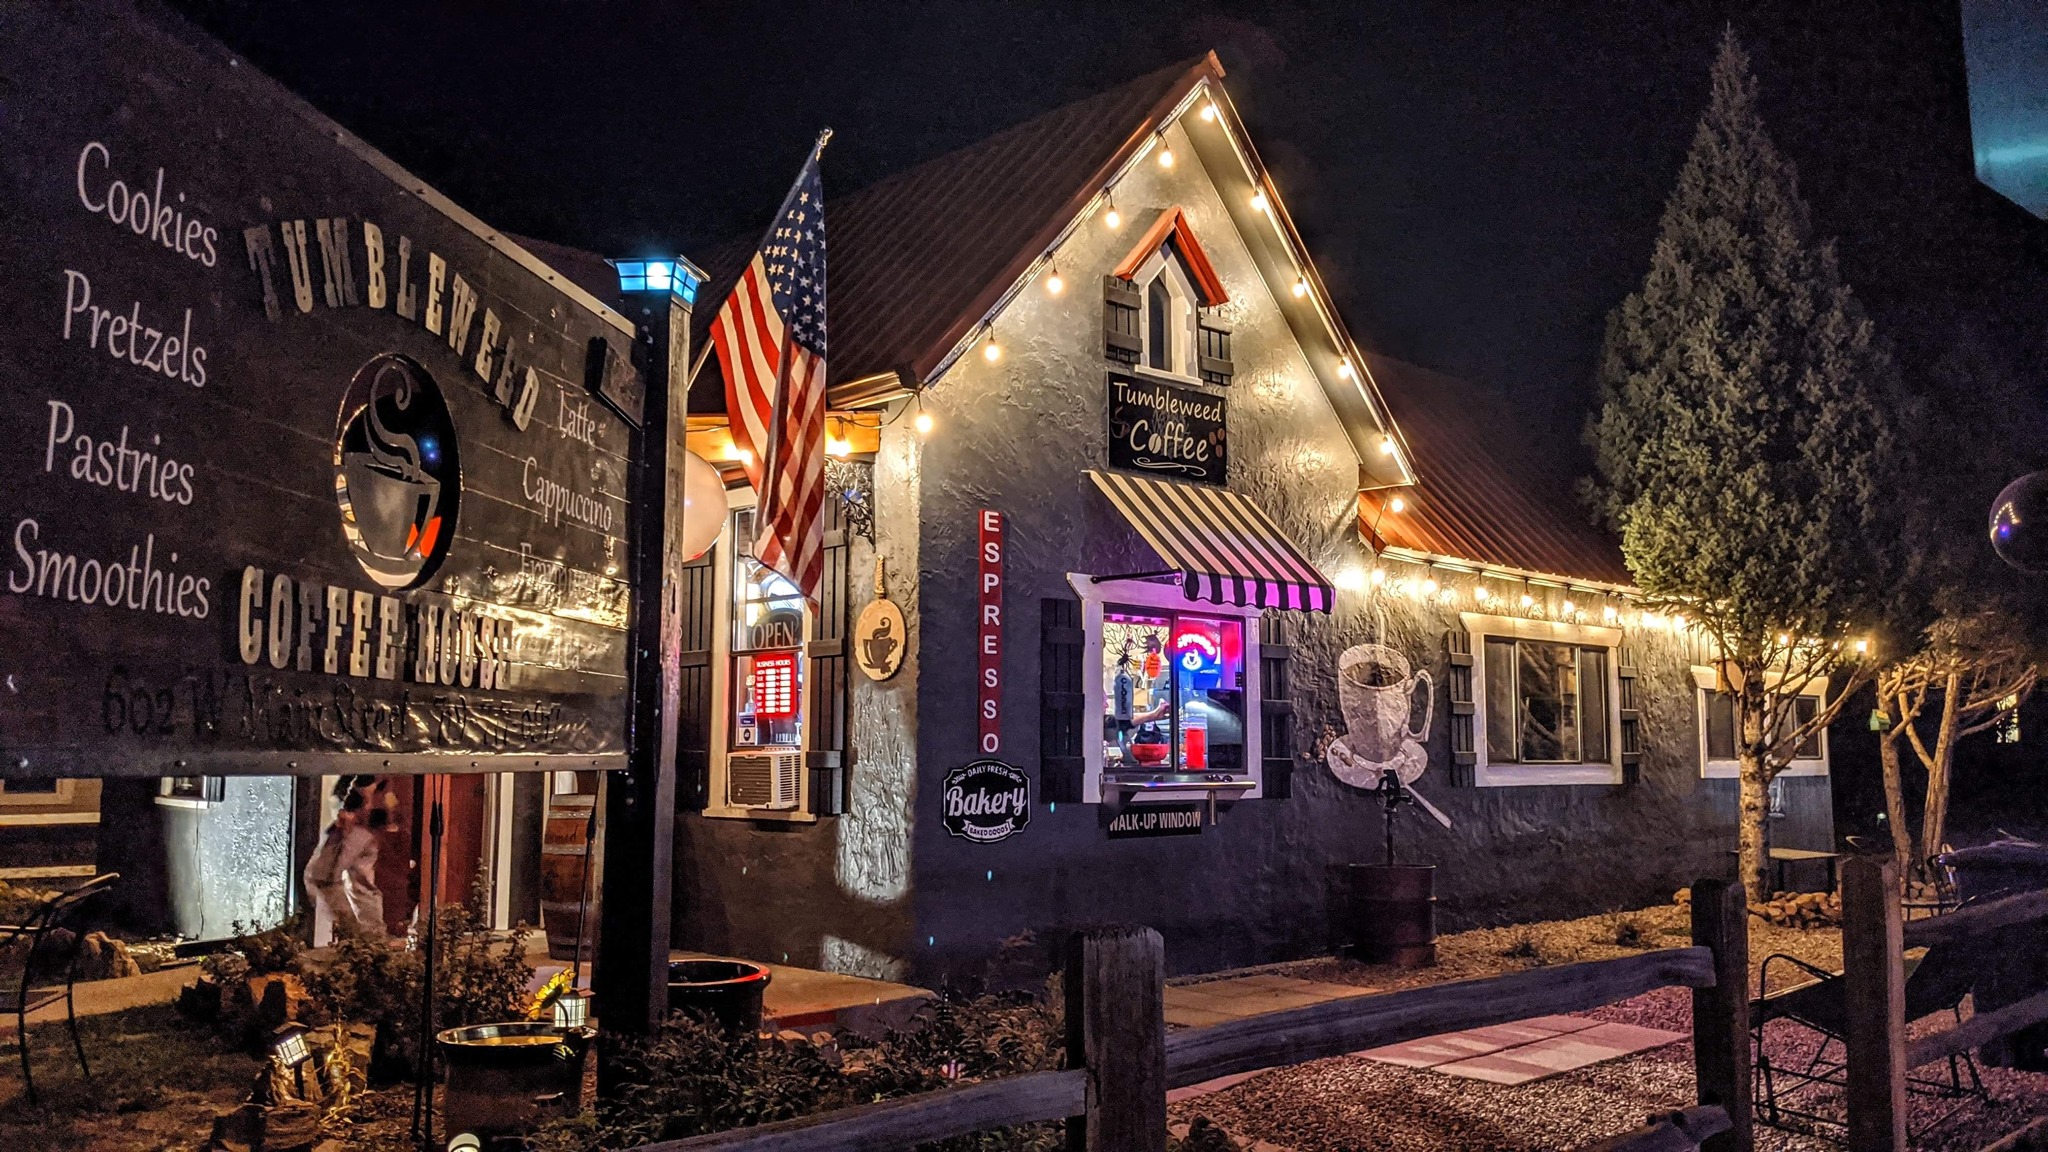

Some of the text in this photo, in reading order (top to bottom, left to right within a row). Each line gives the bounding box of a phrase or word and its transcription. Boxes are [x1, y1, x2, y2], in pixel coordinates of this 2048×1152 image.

[77, 141, 218, 267] Cookies
[63, 268, 207, 388] Pretzels
[243, 217, 540, 432] TUMBLEWEED
[558, 389, 597, 447] Latte
[1113, 381, 1222, 423] Tumbleweed
[45, 400, 195, 506] Pastries
[1129, 418, 1209, 462] Coffee
[522, 456, 613, 532] Cappuccino
[8, 517, 211, 619] Smoothies
[238, 564, 400, 680] COFFEE
[414, 603, 514, 691] HOUSE
[751, 621, 795, 650] OPEN
[983, 510, 1001, 754] ESPRESSO
[946, 785, 1027, 817] Bakery
[967, 765, 1009, 778] DAILY FRESH
[969, 823, 1009, 837] BAKED GOODS
[1109, 811, 1201, 832] WALK-UP WINDOW
